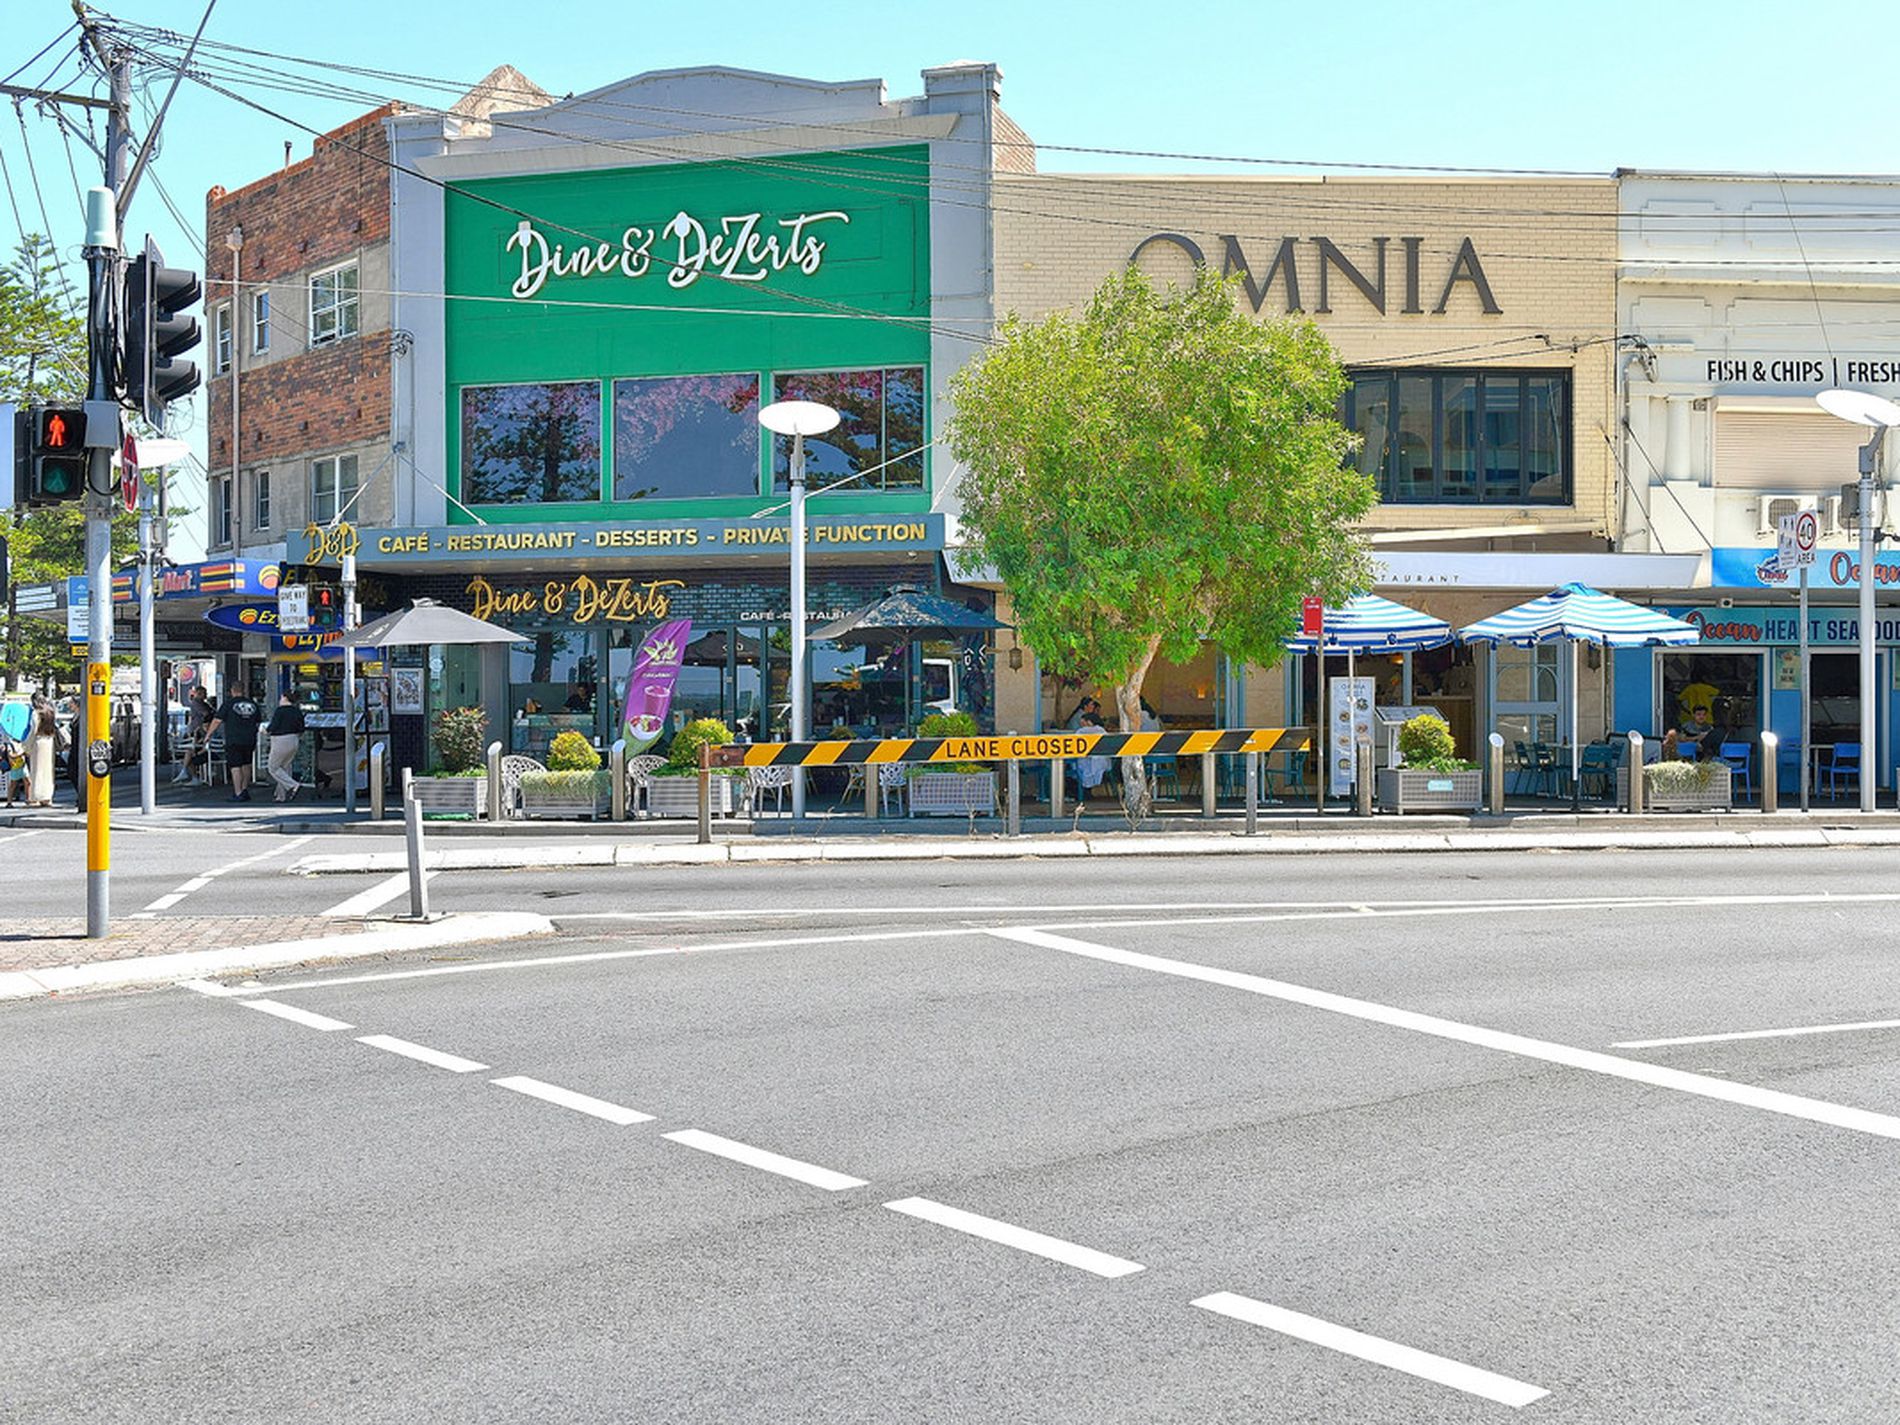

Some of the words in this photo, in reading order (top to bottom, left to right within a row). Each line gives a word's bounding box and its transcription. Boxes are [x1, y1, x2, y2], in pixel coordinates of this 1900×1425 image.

[506, 220, 620, 299] Dine
[620, 227, 655, 278] &
[662, 211, 850, 289] DeZerts
[1127, 232, 1504, 316] OMNIA
[1707, 360, 1747, 382] FISH
[1752, 360, 1766, 382] &
[1771, 360, 1824, 382] CHIPS
[1847, 361, 1900, 383] FRESH
[378, 531, 429, 553] CAFÉ
[447, 532, 576, 552] RESTAURANT
[595, 528, 698, 548] DESSERTS
[723, 526, 809, 546] PRIVAT
[815, 523, 926, 543] FUNCTION
[1800, 522, 1814, 541] 40
[1379, 574, 1459, 583] TAURANT
[1829, 551, 1900, 586] Ocan
[465, 576, 537, 622] Dine
[543, 580, 566, 614] &
[570, 575, 686, 623] DeZerts
[1686, 610, 1763, 642] Ocean
[1765, 620, 1821, 640] HEAT
[946, 740, 1000, 758] LANE
[1011, 738, 1088, 757] CLOSED
